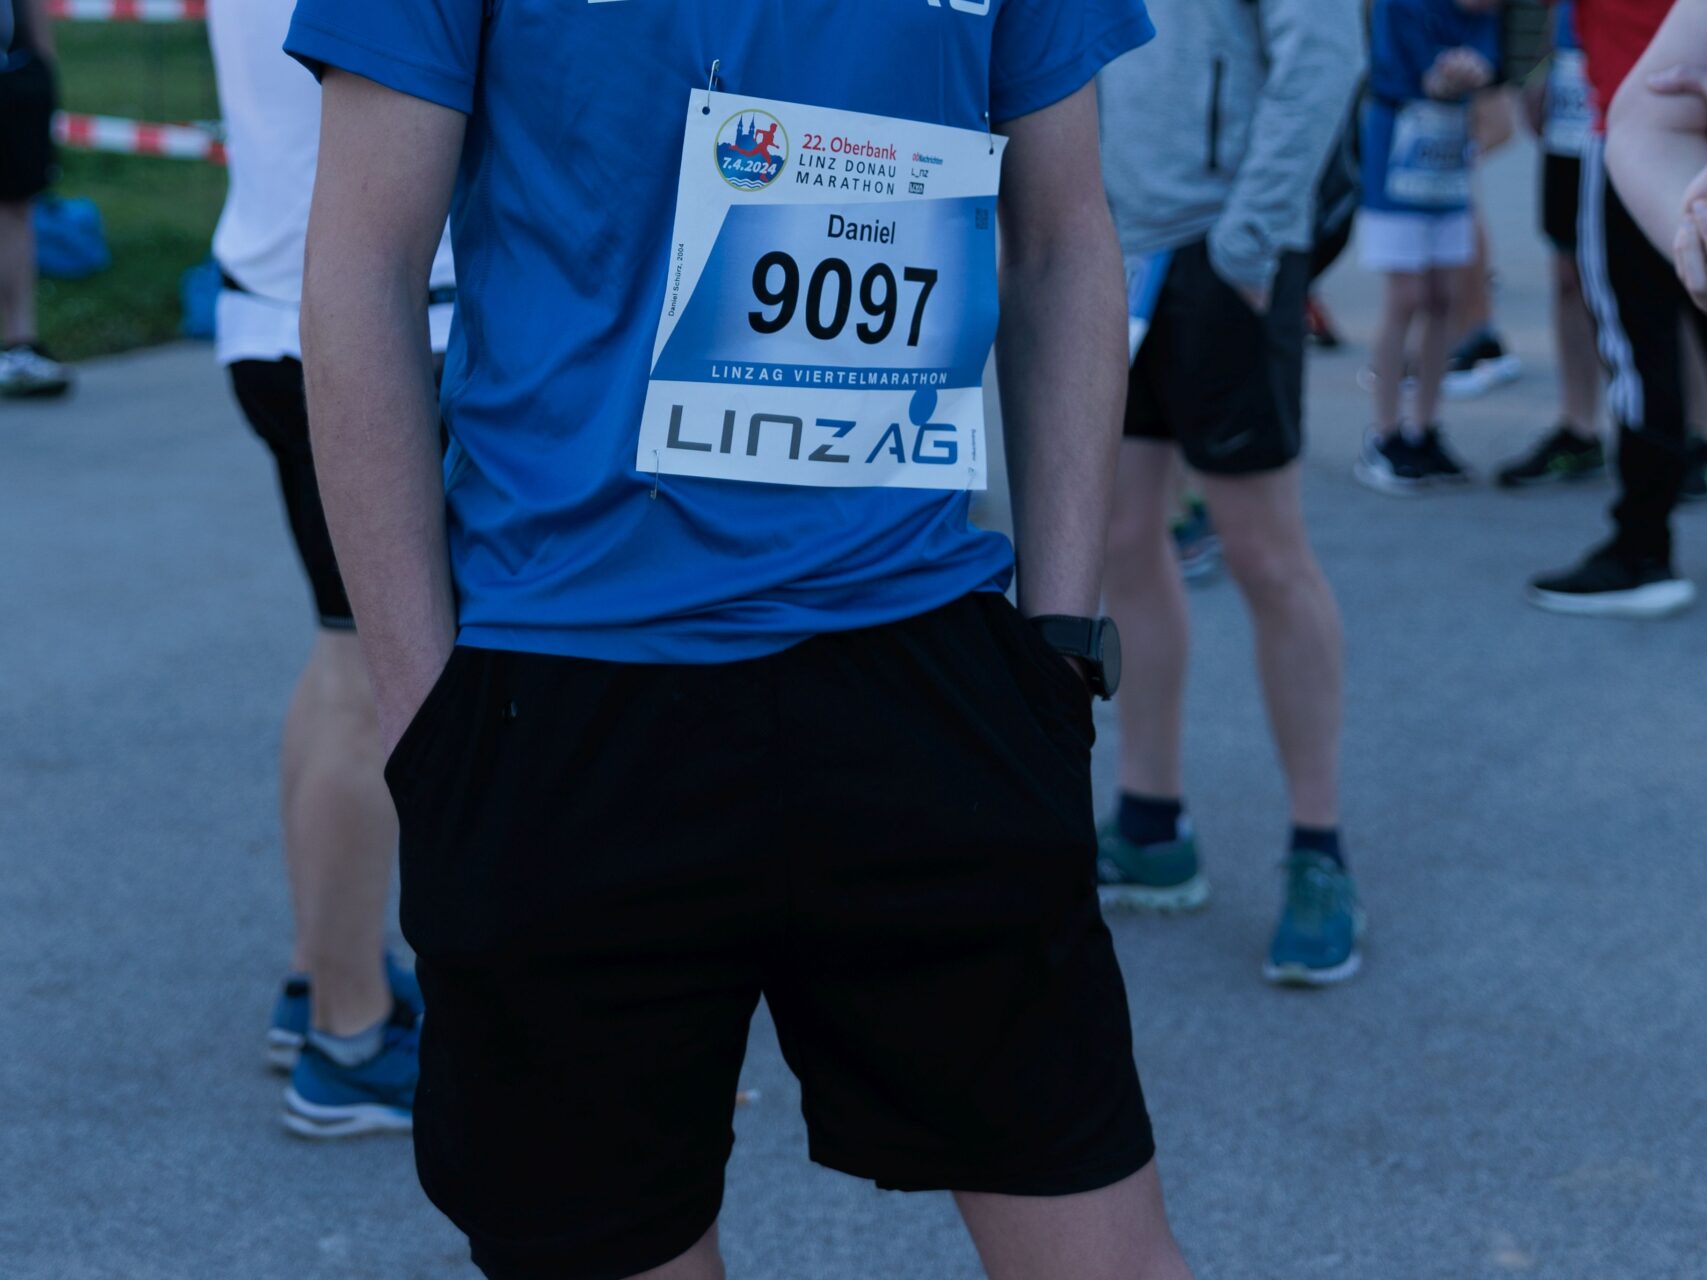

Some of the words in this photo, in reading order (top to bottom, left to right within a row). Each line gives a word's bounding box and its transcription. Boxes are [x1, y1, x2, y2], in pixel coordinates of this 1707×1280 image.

[802, 133, 826, 152] 22.
[830, 137, 897, 161] Oberbank
[722, 156, 777, 176] 7.4.2024
[799, 154, 836, 170] LINZ
[845, 160, 897, 178] DONAU
[795, 171, 895, 196] MARATHON
[827, 213, 896, 245] Daniel
[668, 293, 679, 317] Daniel
[677, 243, 685, 261] 2004
[748, 250, 938, 347] 9097
[794, 370, 948, 385] VIERTELMARATHON
